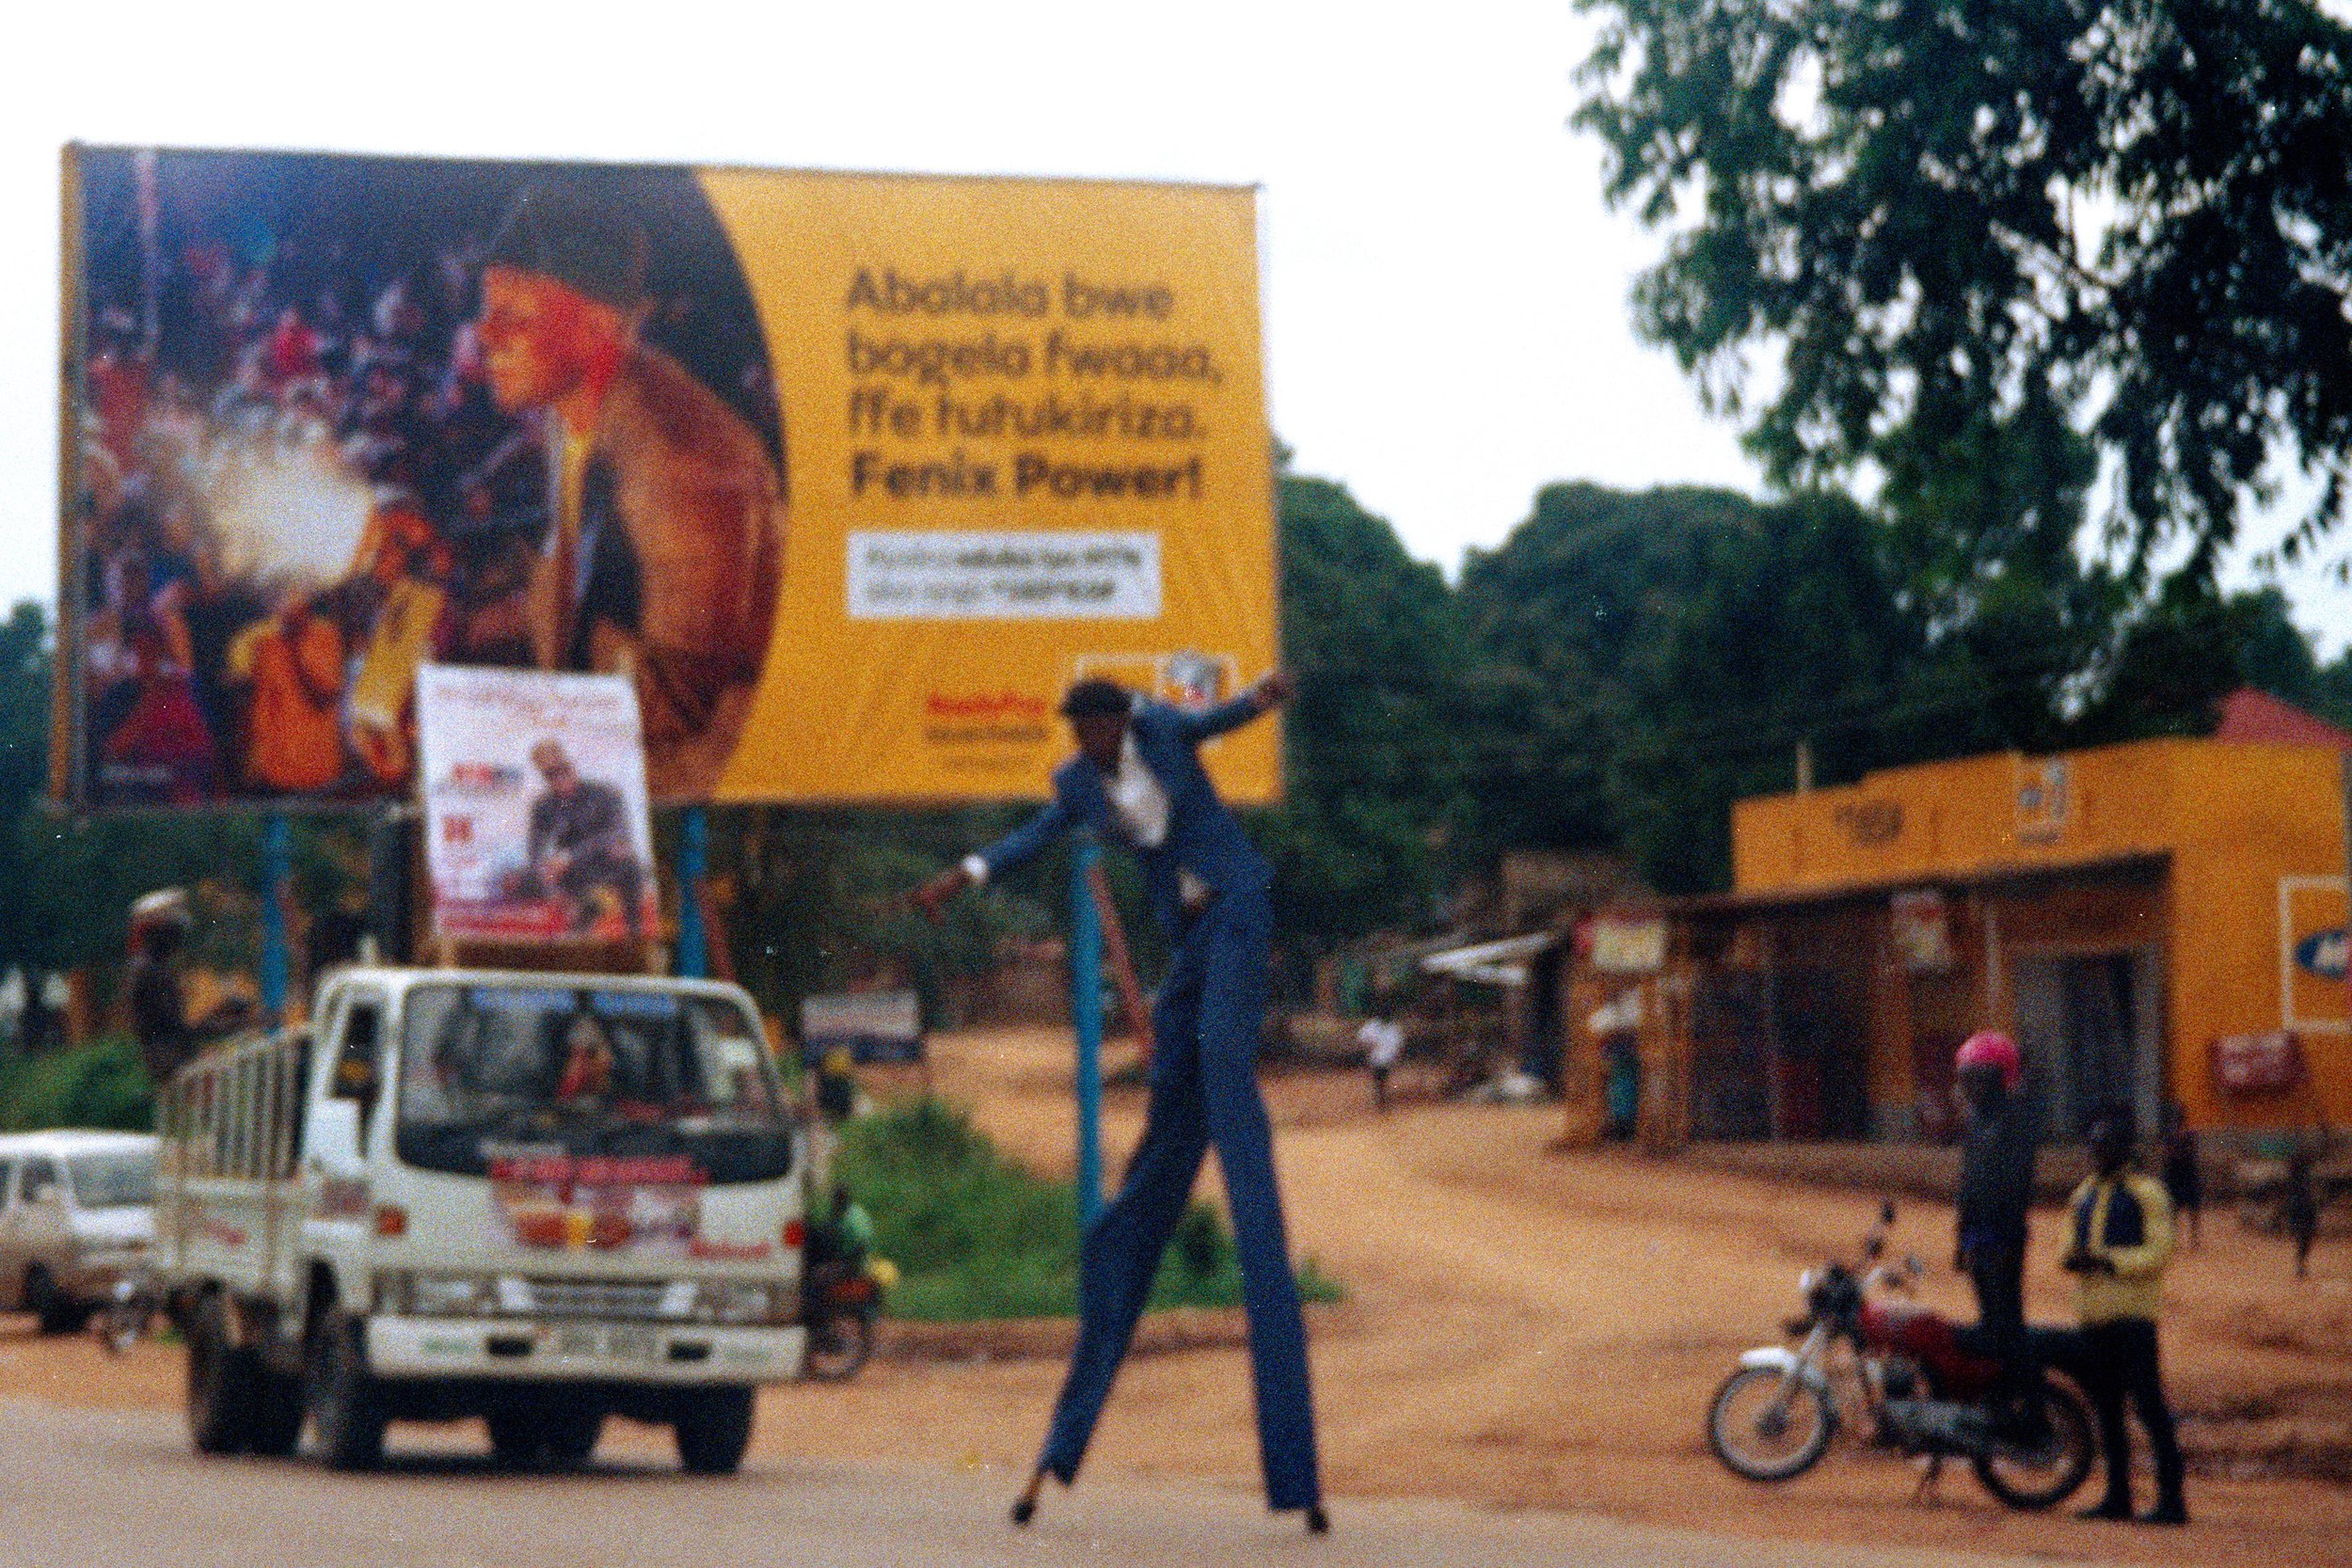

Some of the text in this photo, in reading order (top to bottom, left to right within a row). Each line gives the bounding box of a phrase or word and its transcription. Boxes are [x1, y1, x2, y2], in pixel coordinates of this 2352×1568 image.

[850, 269, 1172, 320] Abalala bwe
[853, 451, 996, 498] Fenix
